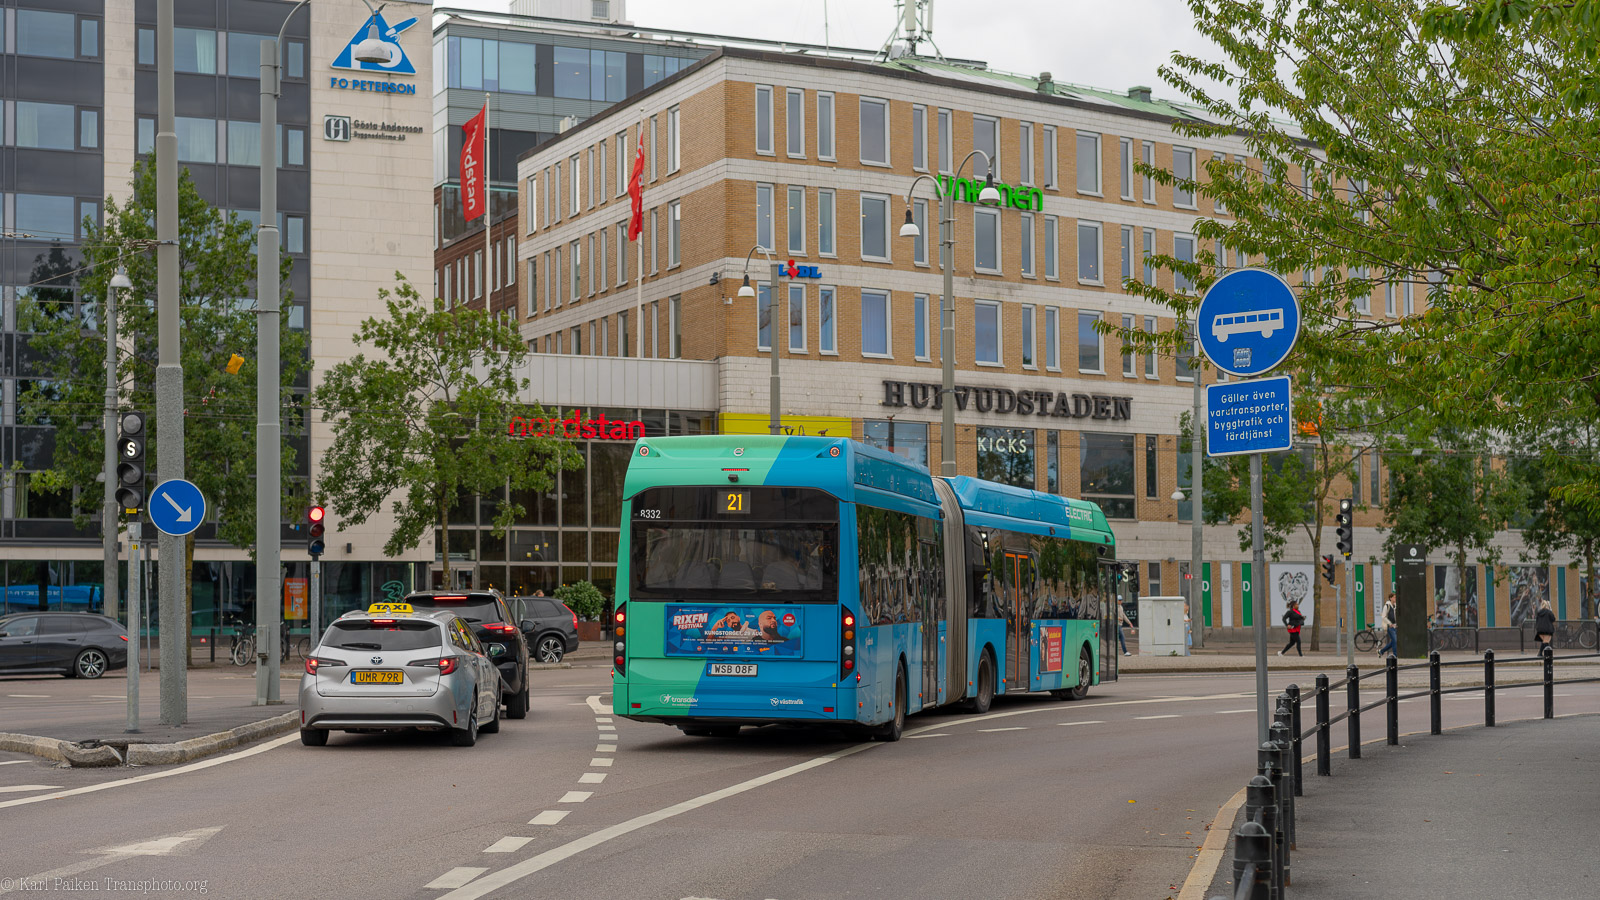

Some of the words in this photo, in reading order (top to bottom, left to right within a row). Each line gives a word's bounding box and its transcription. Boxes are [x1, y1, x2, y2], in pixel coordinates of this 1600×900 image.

[331, 78, 348, 89] FO
[352, 79, 415, 94] PETERSON
[354, 119, 378, 130] Gösta
[381, 121, 423, 133] Andersson
[464, 124, 478, 211] rdstan
[1221, 393, 1249, 403] Gäller
[1253, 391, 1275, 400] även
[1210, 403, 1288, 417] varutransporter,
[509, 409, 646, 440] nordstan
[1214, 417, 1262, 431] byggtrafik
[1267, 415, 1283, 424] och
[1225, 429, 1273, 441] färdtjänst
[127, 441, 136, 457] S
[977, 436, 1027, 453] KICKS
[727, 493, 742, 511] 21
[1065, 506, 1093, 522] ELECTRIC
[1242, 581, 1250, 592] D
[1355, 582, 1363, 592] D
[673, 613, 708, 625] RIXFM
[714, 664, 733, 673] WSB
[735, 665, 753, 674] 08F
[360, 673, 377, 681] UMR
[381, 673, 399, 681] 79R
